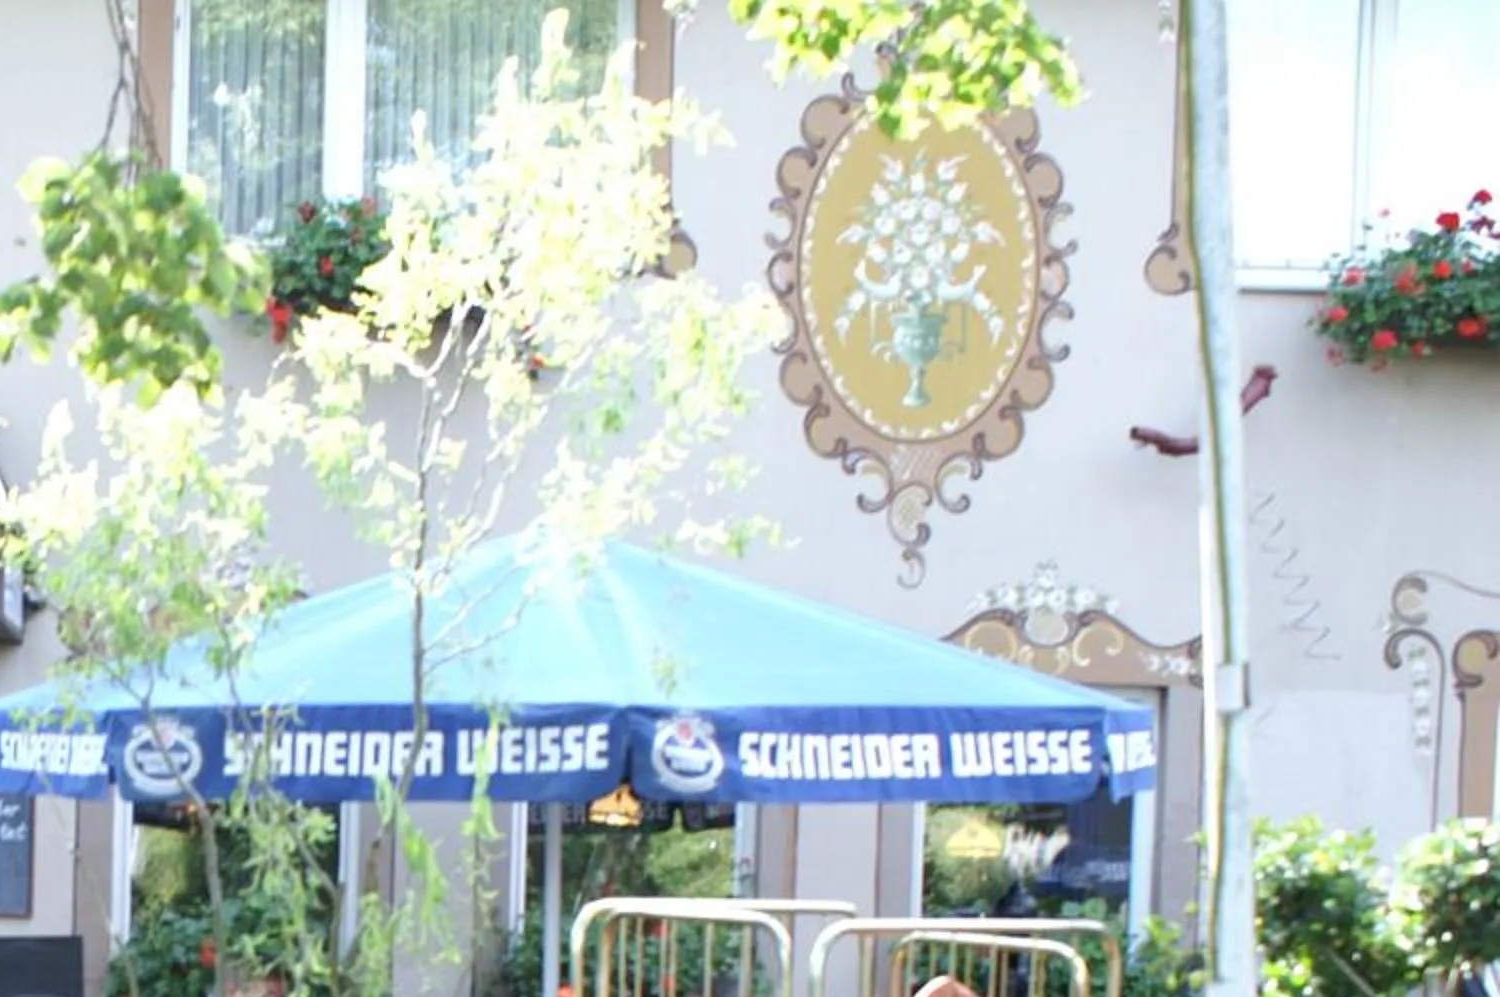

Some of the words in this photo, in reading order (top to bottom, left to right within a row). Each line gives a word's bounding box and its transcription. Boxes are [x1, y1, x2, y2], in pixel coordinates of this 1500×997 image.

[457, 723, 609, 775] WEISSE
[739, 731, 942, 779] SCHNEIDER
[950, 729, 1093, 776] WEISSE
